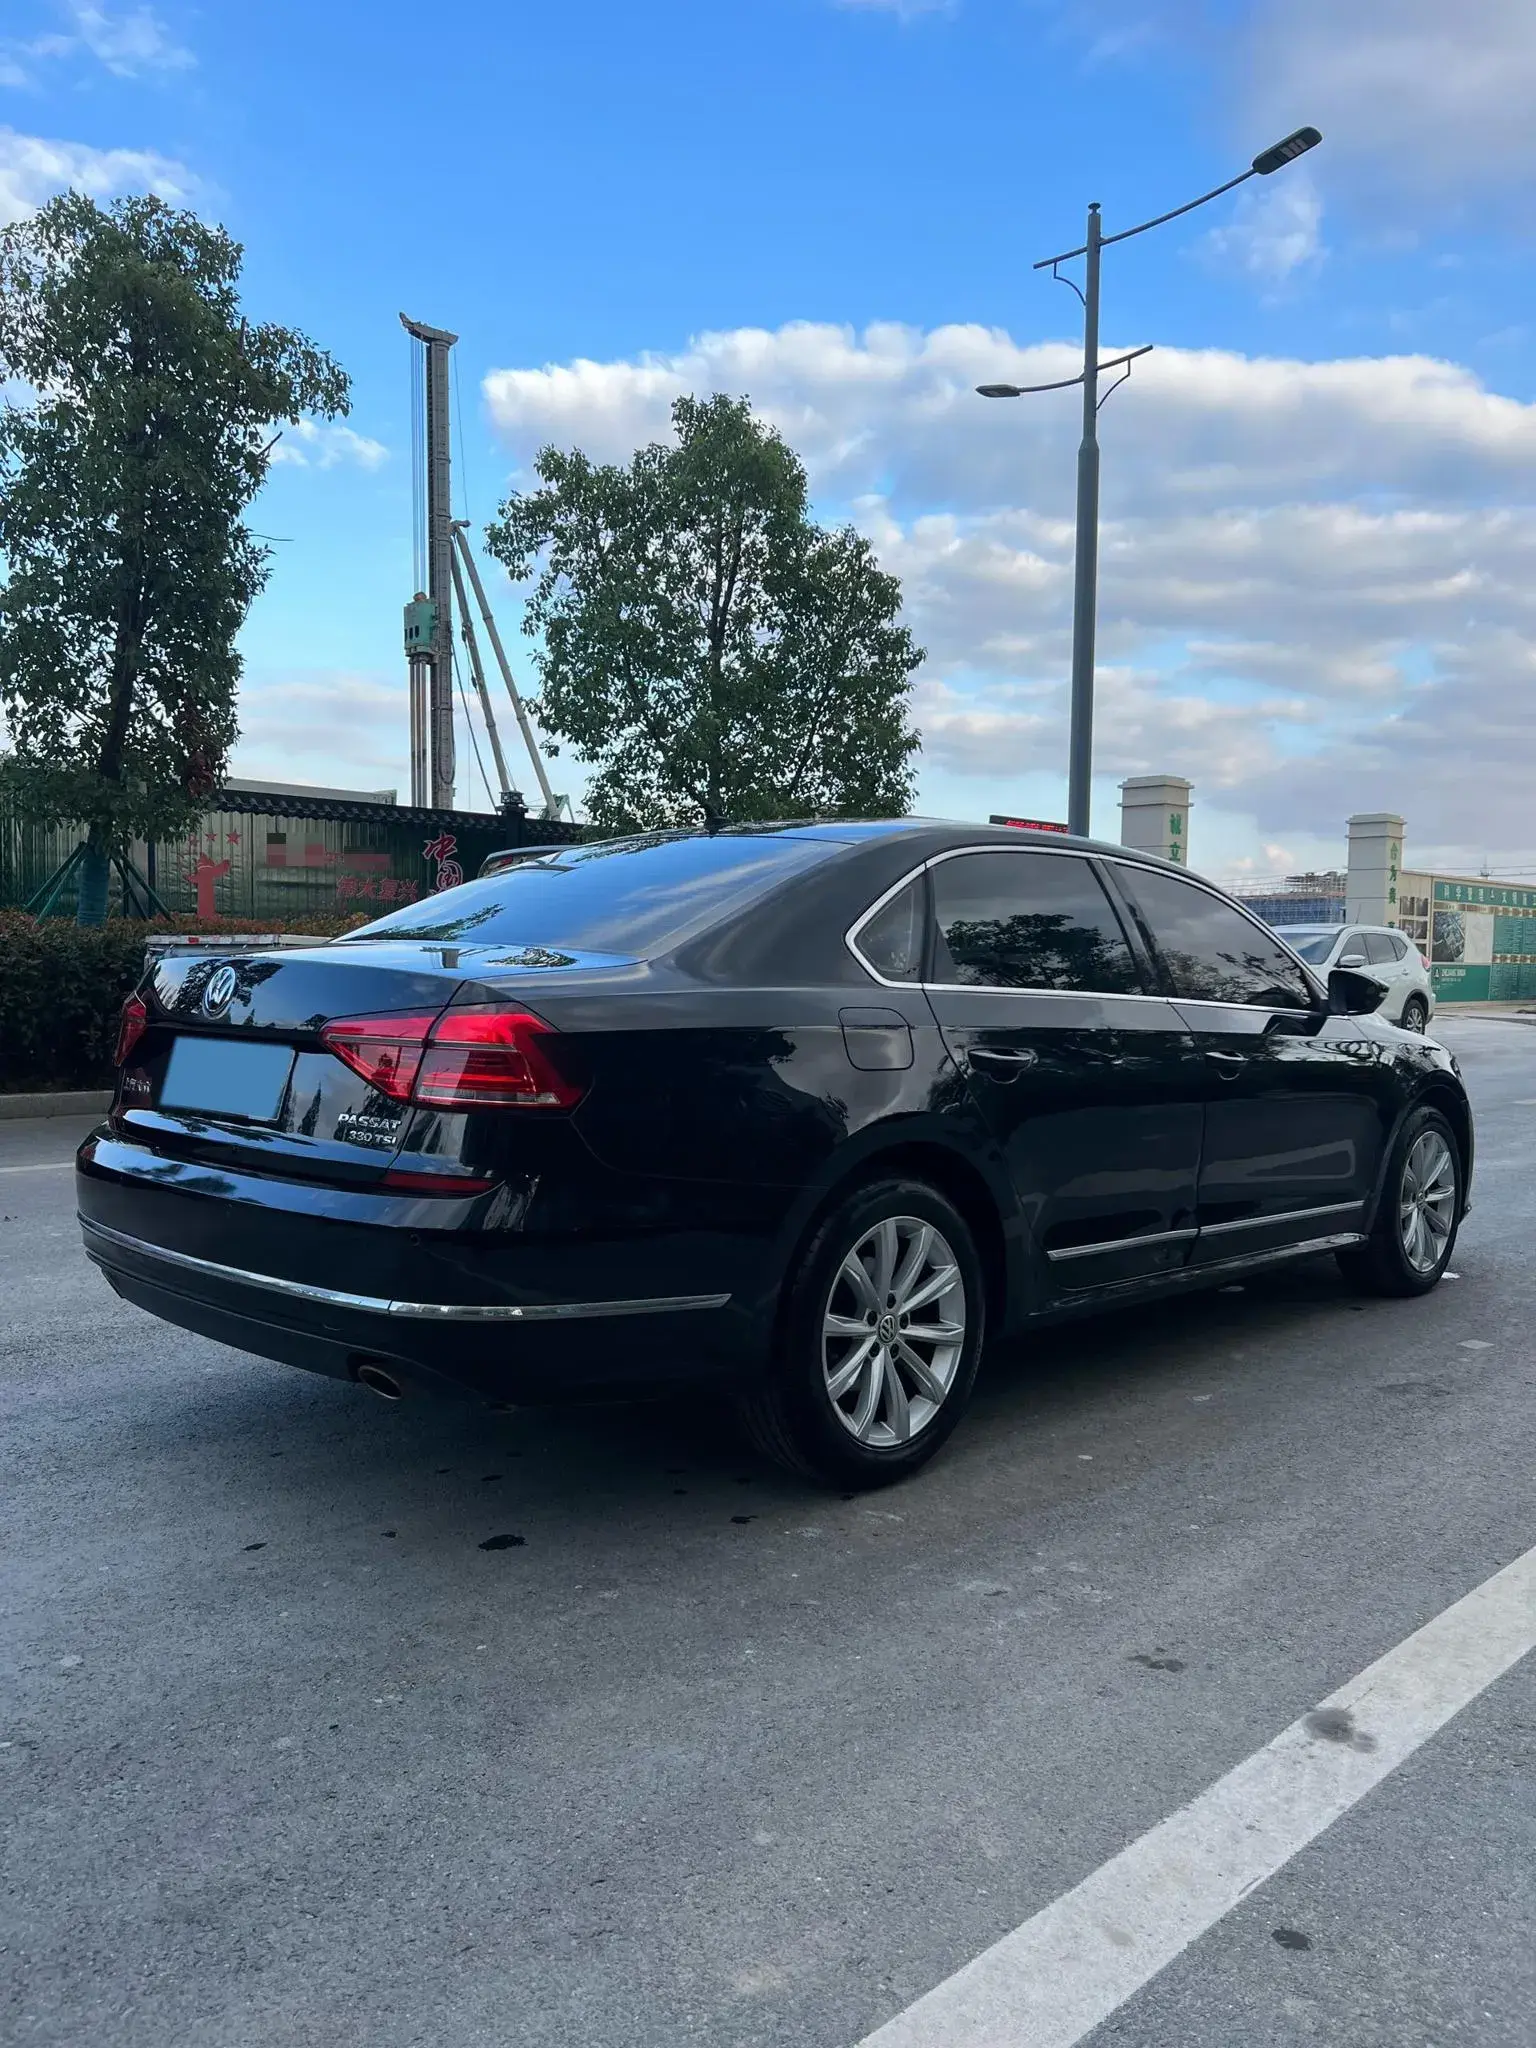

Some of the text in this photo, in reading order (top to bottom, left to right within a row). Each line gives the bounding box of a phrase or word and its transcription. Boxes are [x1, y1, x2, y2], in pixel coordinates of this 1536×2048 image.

[337, 1113, 402, 1131] PASSAT
[348, 1130, 397, 1144] 330 TSI
